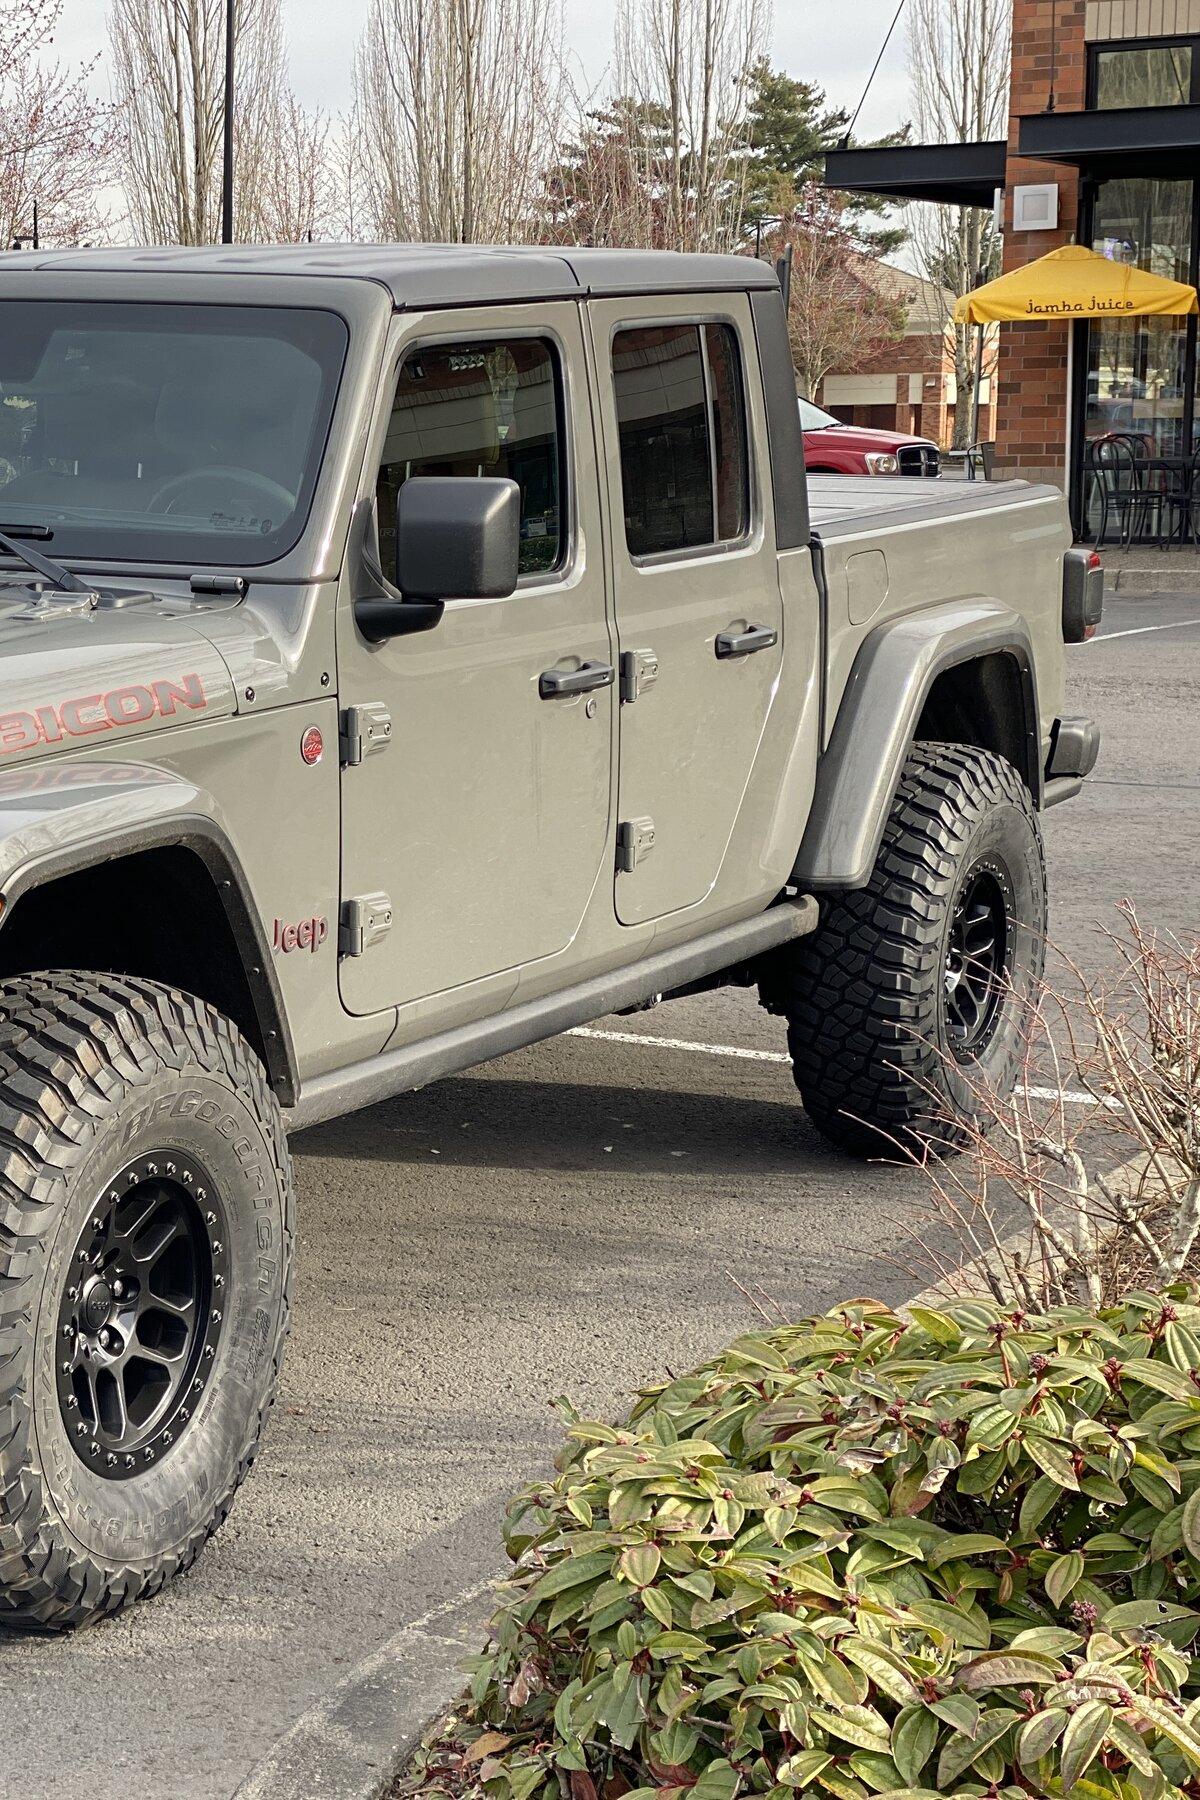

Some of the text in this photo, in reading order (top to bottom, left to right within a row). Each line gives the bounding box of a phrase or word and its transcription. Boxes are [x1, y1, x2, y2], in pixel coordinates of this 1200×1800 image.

[1026, 299, 1084, 314] jamba
[272, 915, 329, 955] Jeep
[121, 1089, 277, 1295] BFGoodrich
